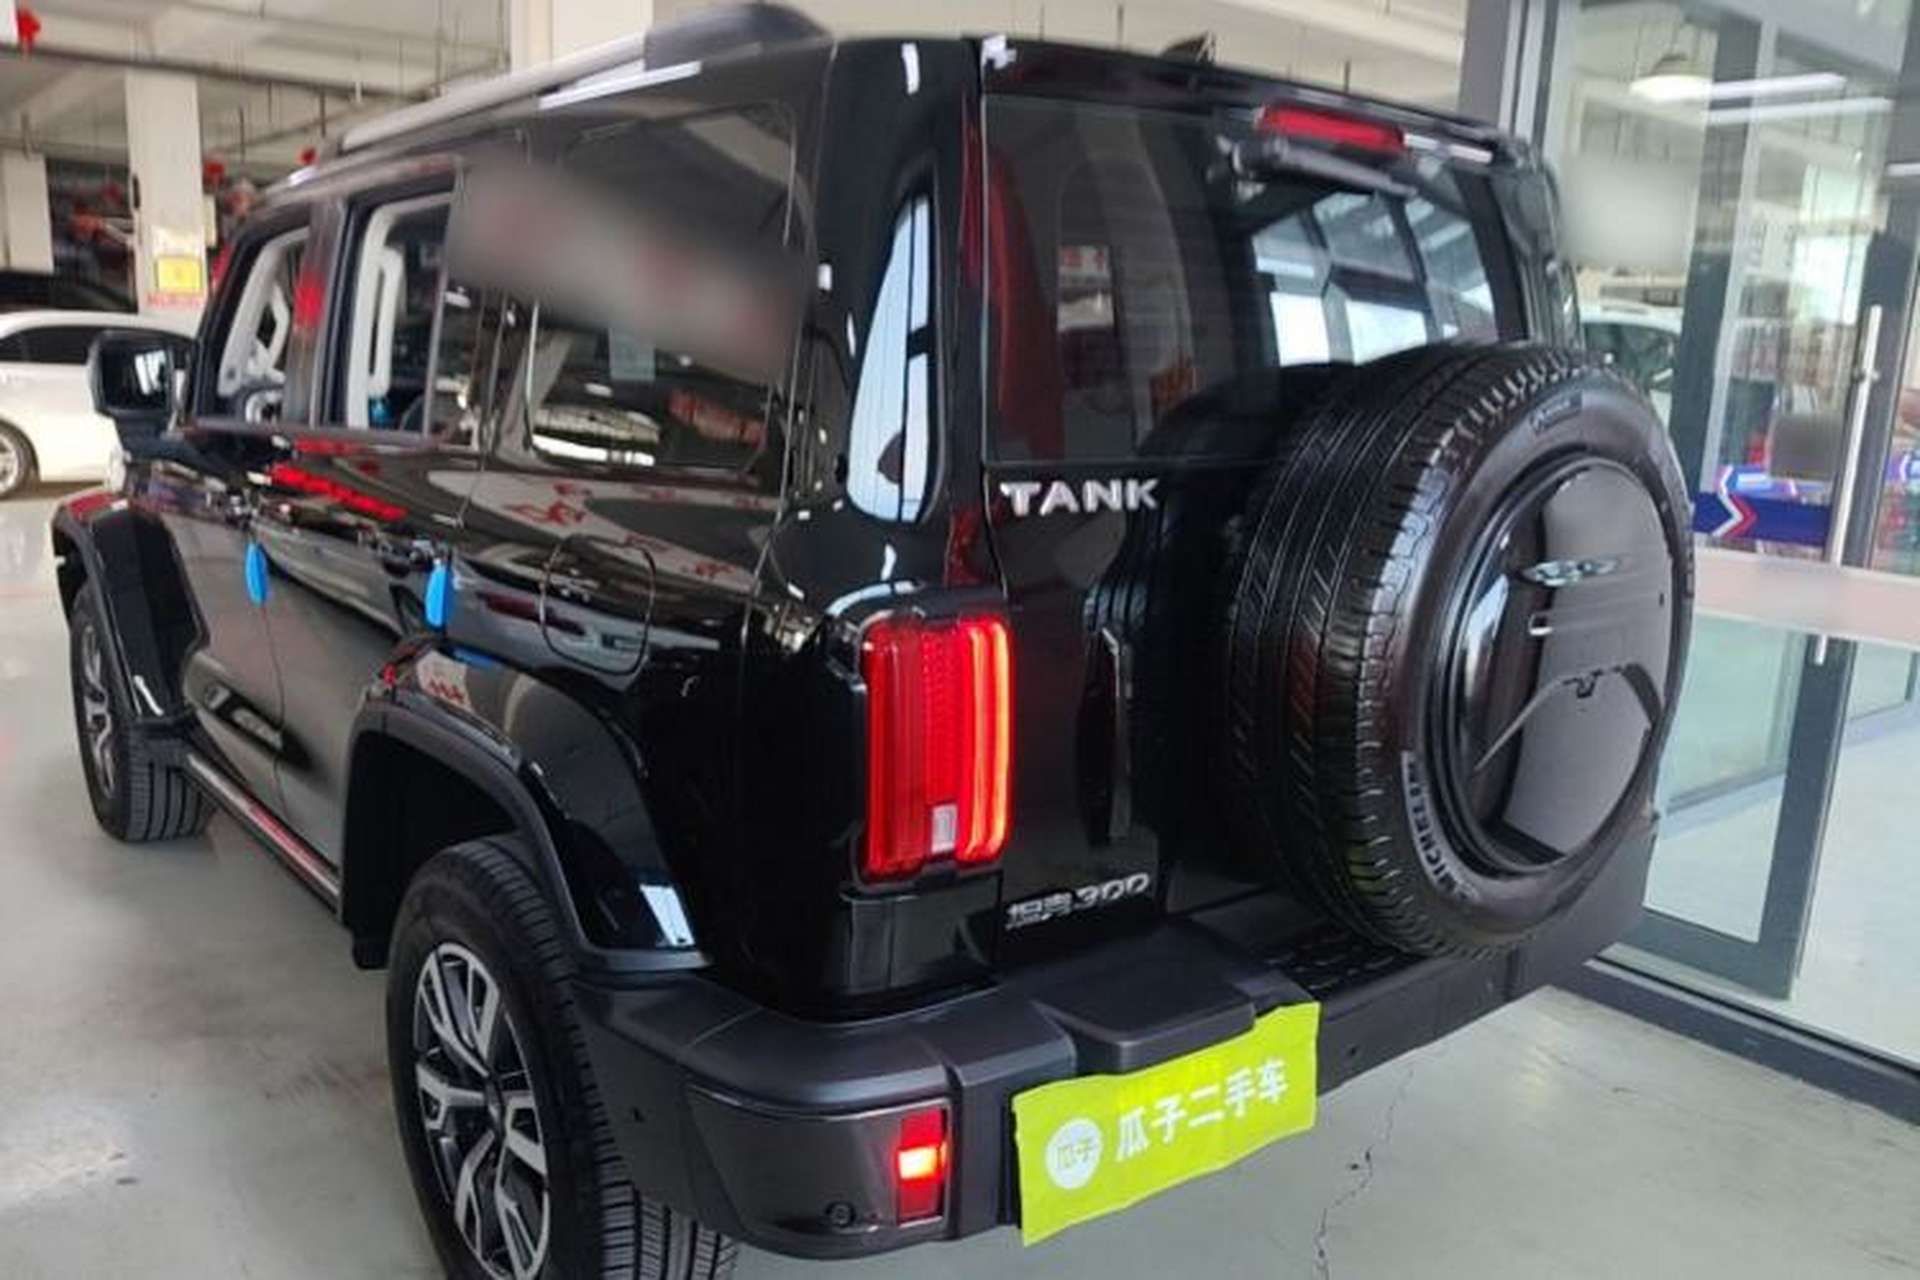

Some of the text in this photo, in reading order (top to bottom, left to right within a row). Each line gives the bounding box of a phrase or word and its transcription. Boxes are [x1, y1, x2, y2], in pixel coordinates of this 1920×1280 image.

[1000, 479, 1158, 517] TANK
[1005, 872, 1149, 930] 坦克300
[1116, 1058, 1288, 1161] 瓜子二手车
